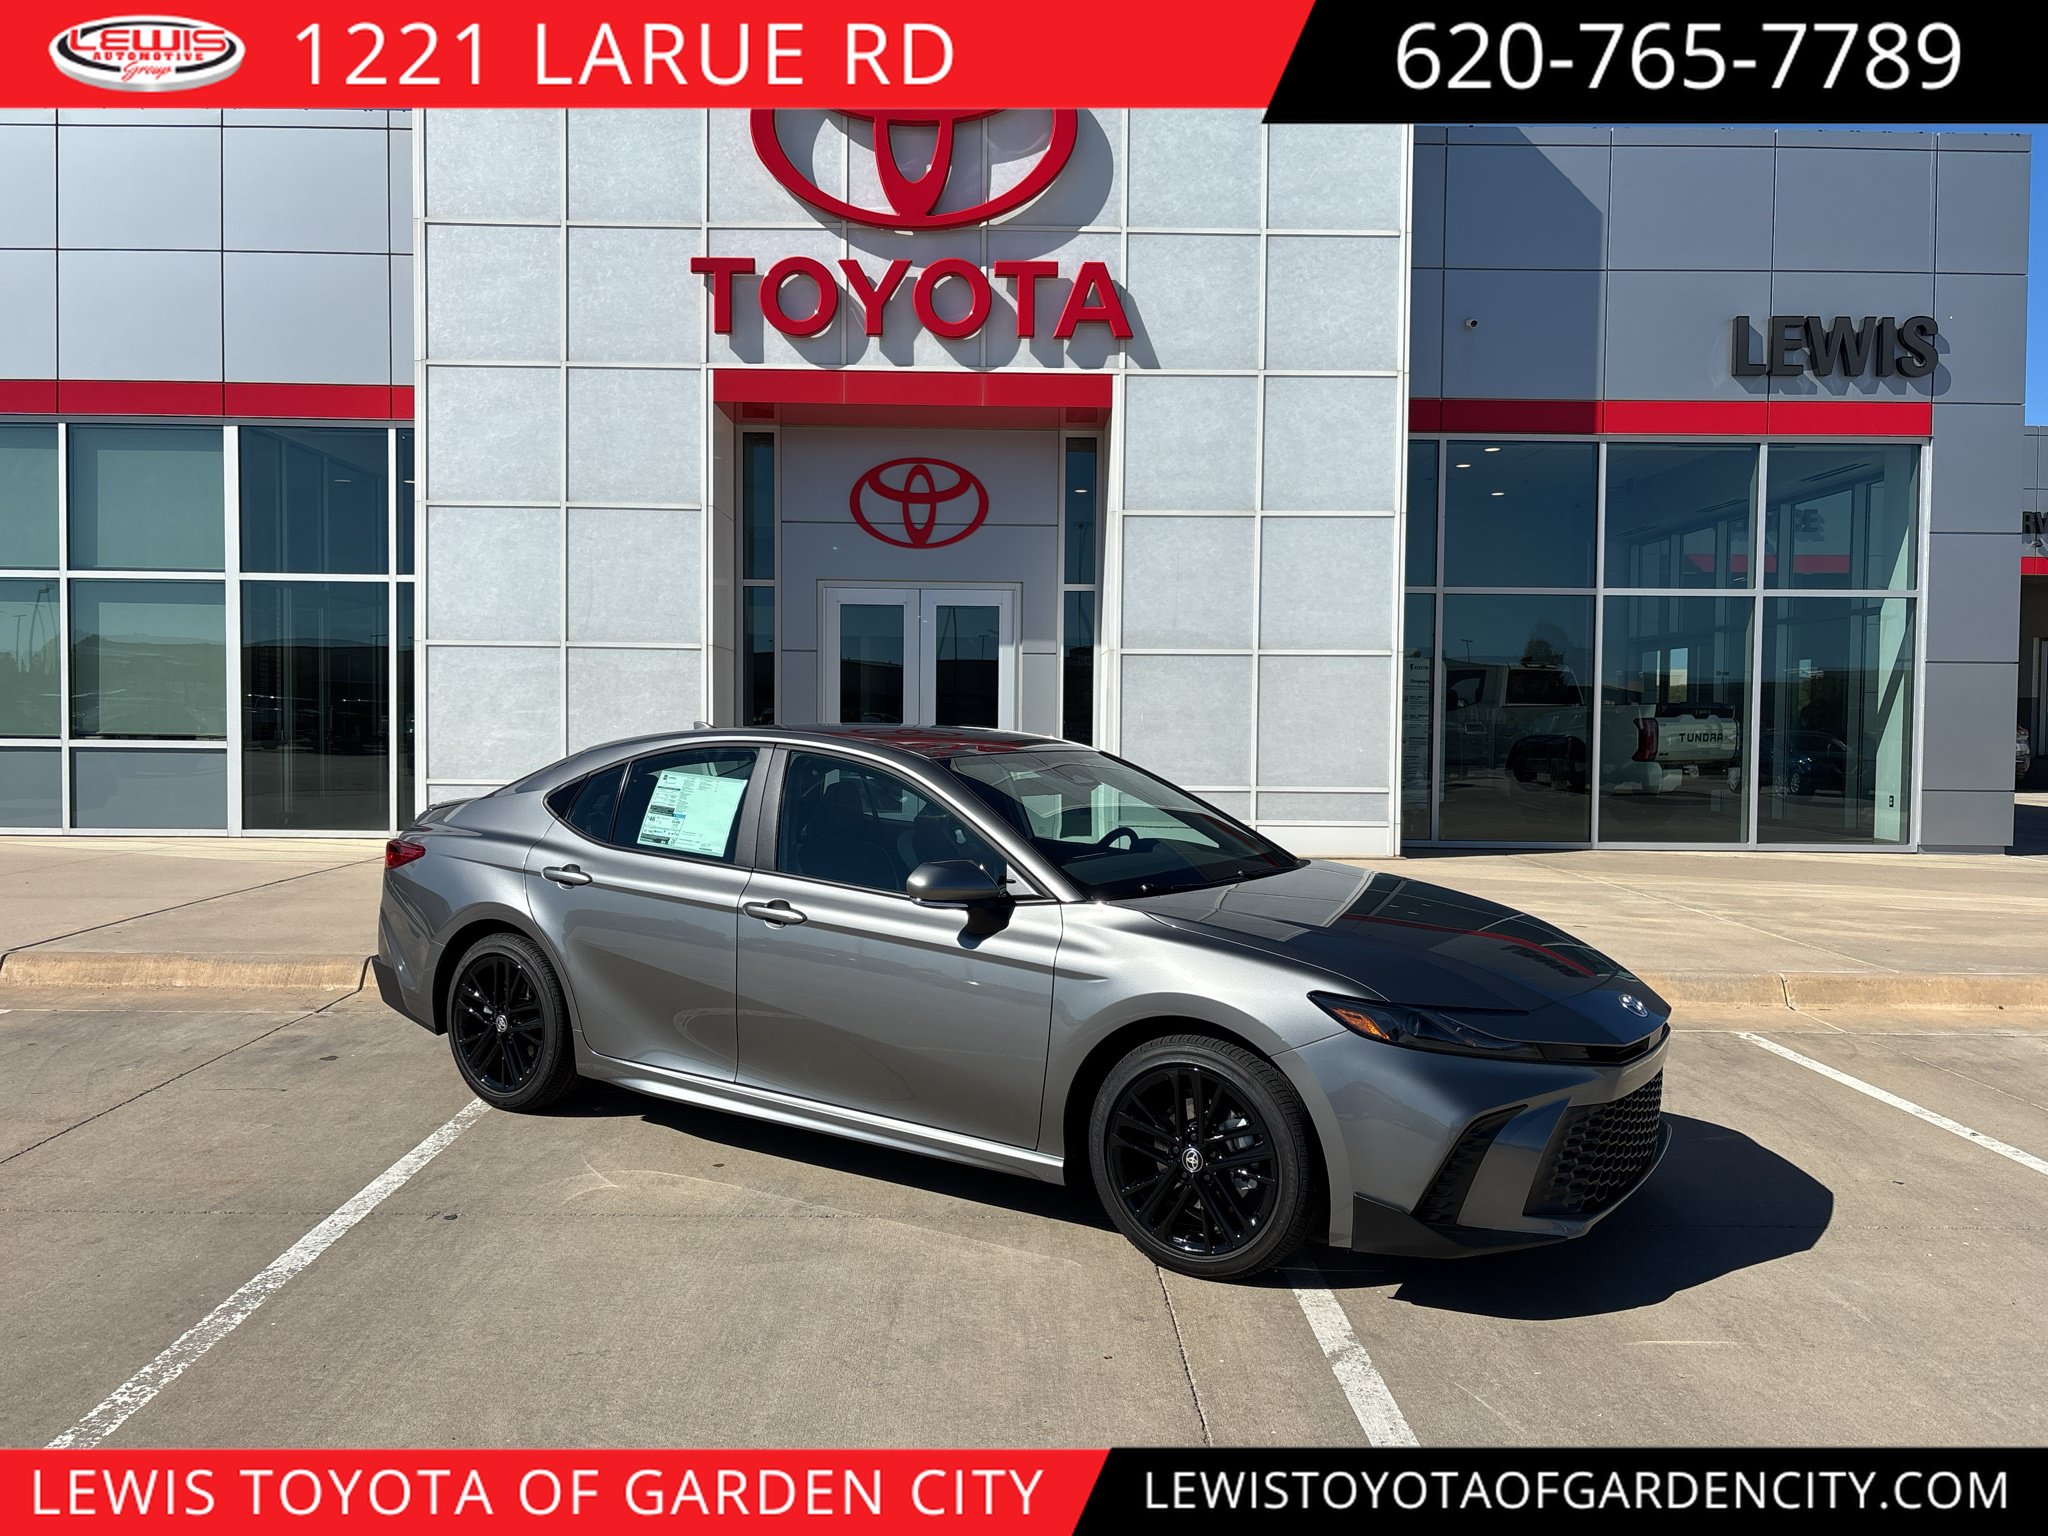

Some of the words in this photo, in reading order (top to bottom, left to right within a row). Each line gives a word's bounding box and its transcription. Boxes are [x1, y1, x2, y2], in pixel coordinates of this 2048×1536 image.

[690, 256, 1134, 340] TOYOTA
[1731, 315, 1939, 378] LEWIS
[1679, 732, 1724, 743] TUNDRA
